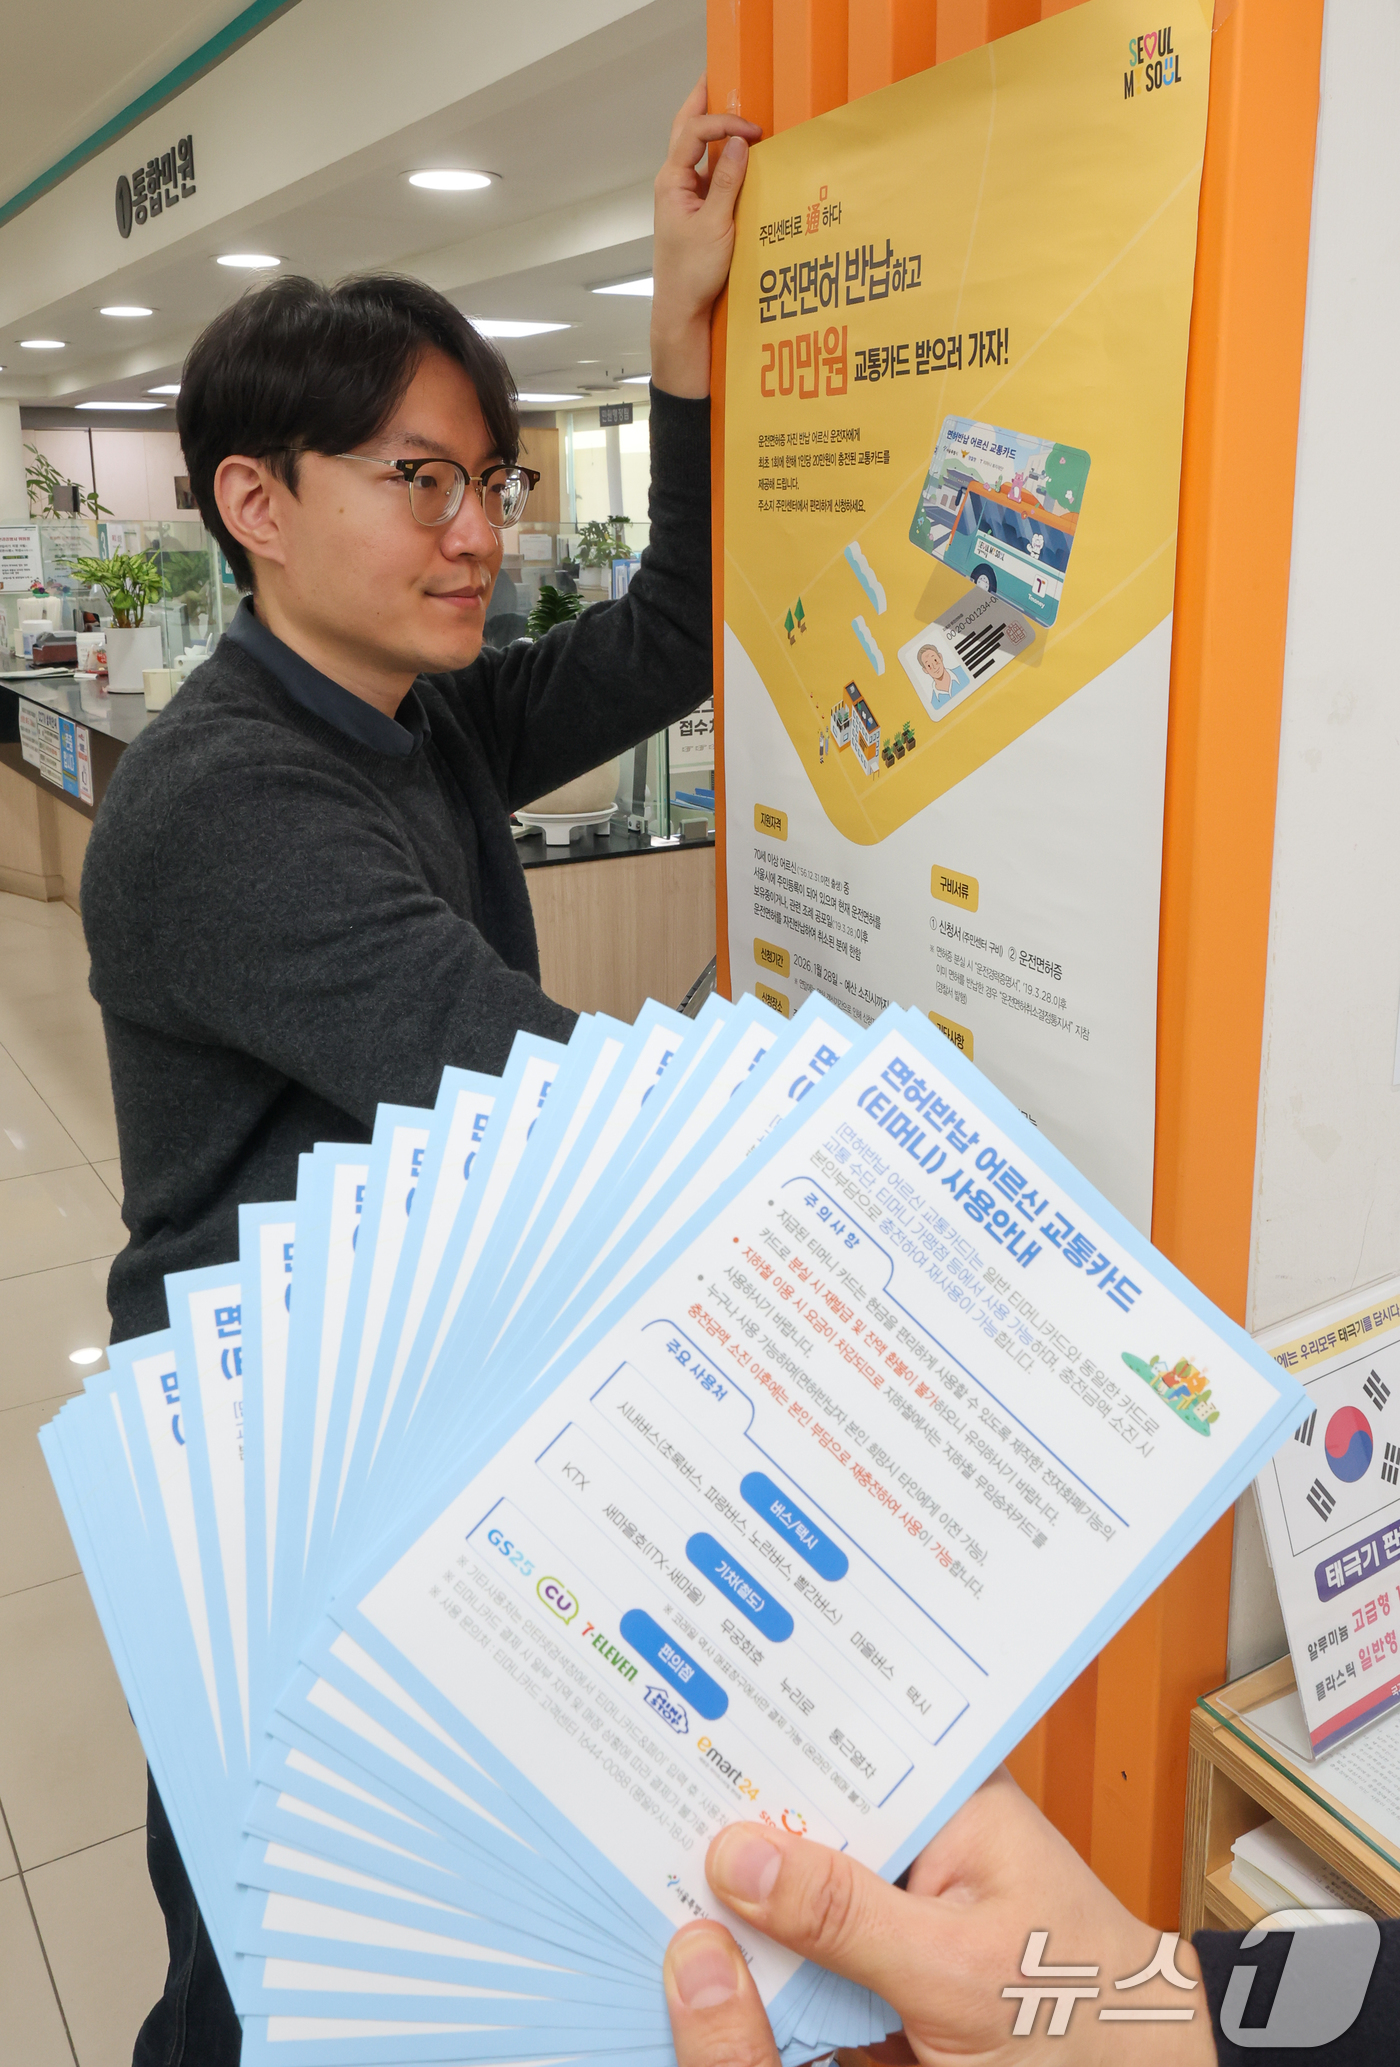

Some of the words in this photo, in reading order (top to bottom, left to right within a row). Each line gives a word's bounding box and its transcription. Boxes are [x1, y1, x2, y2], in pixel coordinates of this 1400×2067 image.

[132, 134, 196, 225] 통합민원
[759, 215, 803, 247] 주민센터로
[759, 252, 840, 324] 운전면허
[845, 238, 922, 306] 반납하고
[760, 325, 848, 400] 20만원
[854, 344, 910, 383] 교통카드
[916, 335, 963, 376] 받으러
[968, 327, 1009, 368] 가자!
[858, 450, 890, 465] 교통카드를
[946, 429, 971, 445] 면허반납
[970, 436, 990, 450] 어르신
[989, 442, 1017, 460] 교통카드
[760, 813, 782, 832] 지원자격
[753, 866, 776, 885] 서울시에
[776, 875, 805, 897] 주민등록이
[818, 892, 837, 910] 있으며
[851, 905, 881, 931] 운전면허를
[779, 857, 797, 874] 어르신
[940, 875, 969, 900] 구비서류
[753, 902, 782, 925] 운전면허를
[782, 914, 817, 941] 자진반납하여
[817, 929, 835, 949] 취소된
[761, 947, 783, 968] 신청기간
[939, 919, 962, 942] 신청서
[1018, 949, 1063, 981] 운전면허증
[1075, 1024, 1090, 1042] 지참
[856, 1085, 947, 1174] (티머니)
[940, 1168, 1042, 1268] 사용안내
[880, 1056, 980, 1155] 면허반납
[974, 1146, 1049, 1223] 어르신
[1038, 1211, 1142, 1313] 교통카드
[809, 1149, 883, 1223] 본인부담으로
[878, 1217, 929, 1268] 충전하여
[924, 1262, 976, 1314] 재사용이
[971, 1308, 1035, 1375] 가능합니다.
[822, 1135, 852, 1165] 교통
[849, 1163, 877, 1194] 수단,
[875, 1186, 915, 1227] 티머니
[910, 1221, 950, 1262] 가맹점
[946, 1256, 986, 1298] 등에서
[981, 1294, 1010, 1321] 사용
[1006, 1316, 1060, 1373] 가능하며,
[1058, 1365, 1113, 1419] 충전금액
[1107, 1417, 1140, 1444] 소진
[835, 1121, 890, 1176] [면허반납
[887, 1171, 926, 1211] 어르신
[920, 1206, 984, 1272] 교통카드]는
[982, 1266, 1011, 1296] 일반
[1007, 1290, 1082, 1364] 티머니카드와
[1078, 1358, 1121, 1400] 동일한
[1117, 1394, 1160, 1437] 카드로
[723, 1266, 776, 1317] 사용하시기
[771, 1312, 814, 1359] 바랍니다.
[741, 1246, 775, 1281] 지하철
[772, 1276, 795, 1301] 이용
[803, 1308, 838, 1343] 요금이
[834, 1338, 885, 1390] 차감되므로
[882, 1385, 942, 1448] 지하철에서는
[1273, 1351, 1299, 1369] 에는
[1301, 1331, 1337, 1360] 우리모두
[1337, 1315, 1373, 1343] 태극기를
[1373, 1303, 1400, 1327] 답시다
[666, 1338, 691, 1367] 주요
[689, 1363, 728, 1402] 사용처
[758, 1227, 791, 1262] 카드로
[787, 1256, 813, 1283] 분실
[821, 1289, 854, 1323] 재발급
[863, 1330, 888, 1357] 잔액
[884, 1351, 918, 1386] 환불이
[914, 1380, 967, 1434] 불가하오니
[964, 1429, 1018, 1484] 유의하시기
[1014, 1478, 1059, 1527] 바랍니다.
[776, 1208, 810, 1243] 지급된
[806, 1238, 840, 1273] 티머니
[835, 1267, 867, 1302] 카드는
[865, 1296, 898, 1331] 현금을
[895, 1325, 939, 1371] 편리하게
[934, 1366, 969, 1400] 사용할
[977, 1407, 1012, 1442] 있도록
[1009, 1437, 1044, 1473] 제작한
[1041, 1467, 1116, 1542] 전자화폐기능의
[687, 1303, 731, 1346] 충전금액
[726, 1343, 753, 1368] 소진
[749, 1362, 789, 1406] 이후에는
[787, 1401, 813, 1428] 본인
[810, 1422, 852, 1467] 부담으로
[849, 1461, 902, 1516] 재충전하여
[898, 1511, 933, 1546] 사용이
[929, 1541, 984, 1600] 가능합니다.
[707, 1282, 740, 1318] 누구나
[735, 1314, 760, 1339] 사용
[843, 1420, 870, 1447] 본인
[865, 1442, 901, 1477] 희망시
[897, 1472, 941, 1517] 타인에게
[938, 1512, 963, 1539] 이전
[959, 1533, 988, 1567] 가능),
[769, 1500, 819, 1550] 버스/택시
[703, 1485, 747, 1537] 파랑버스,
[748, 1530, 792, 1582] 노란버스,
[793, 1574, 843, 1625] 빨간버스)
[849, 1630, 894, 1681] 마을버스
[905, 1685, 932, 1715] 택시
[1324, 1540, 1379, 1589] 태극기
[487, 1528, 534, 1576] GS25
[543, 1583, 571, 1612] CU
[581, 1621, 638, 1682] 7-ELEVEN
[561, 1461, 591, 1491] KTX
[720, 1618, 765, 1667] 무궁화호
[780, 1677, 815, 1716] 누리로
[828, 1727, 877, 1779] 통근열차
[1307, 1624, 1349, 1662] 알루미늄
[1351, 1591, 1391, 1633] 고급형
[657, 1642, 695, 1683] 편의점
[1315, 1661, 1357, 1702] 플라스틱
[1358, 1629, 1398, 1672] 일반형
